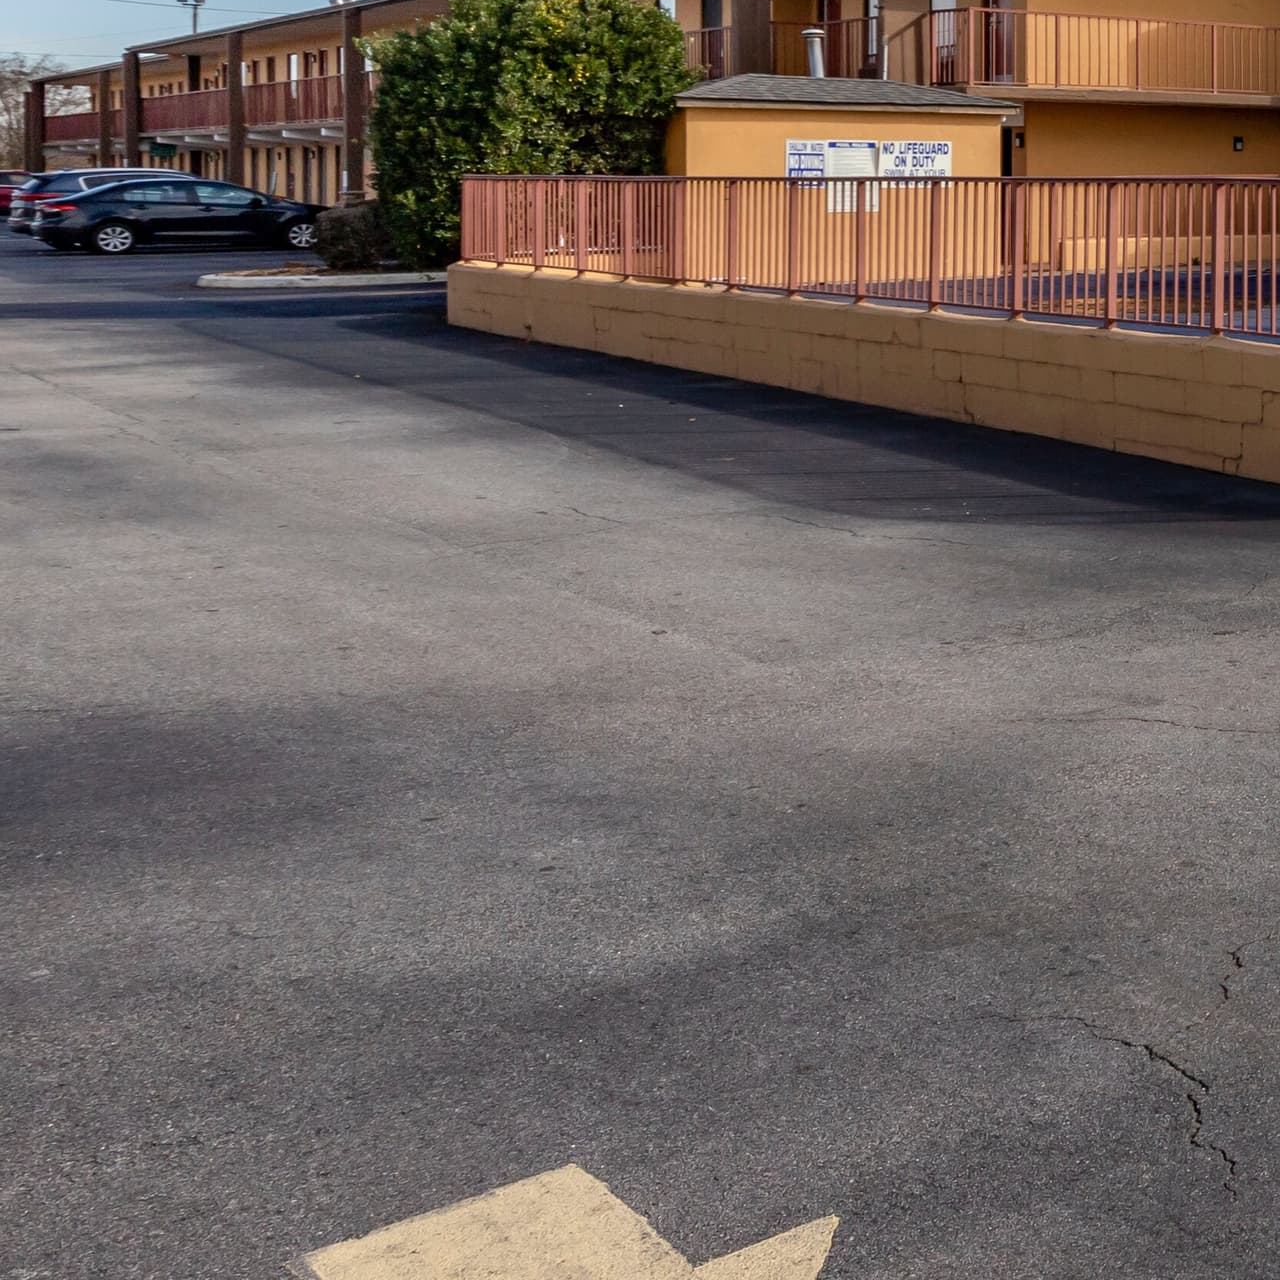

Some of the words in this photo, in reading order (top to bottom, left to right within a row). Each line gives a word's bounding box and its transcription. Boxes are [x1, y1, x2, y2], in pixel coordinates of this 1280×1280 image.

[882, 143, 894, 155] NO
[899, 143, 949, 155] LIFEGUARD
[894, 156, 906, 167] ON
[912, 156, 936, 167] DUTY
